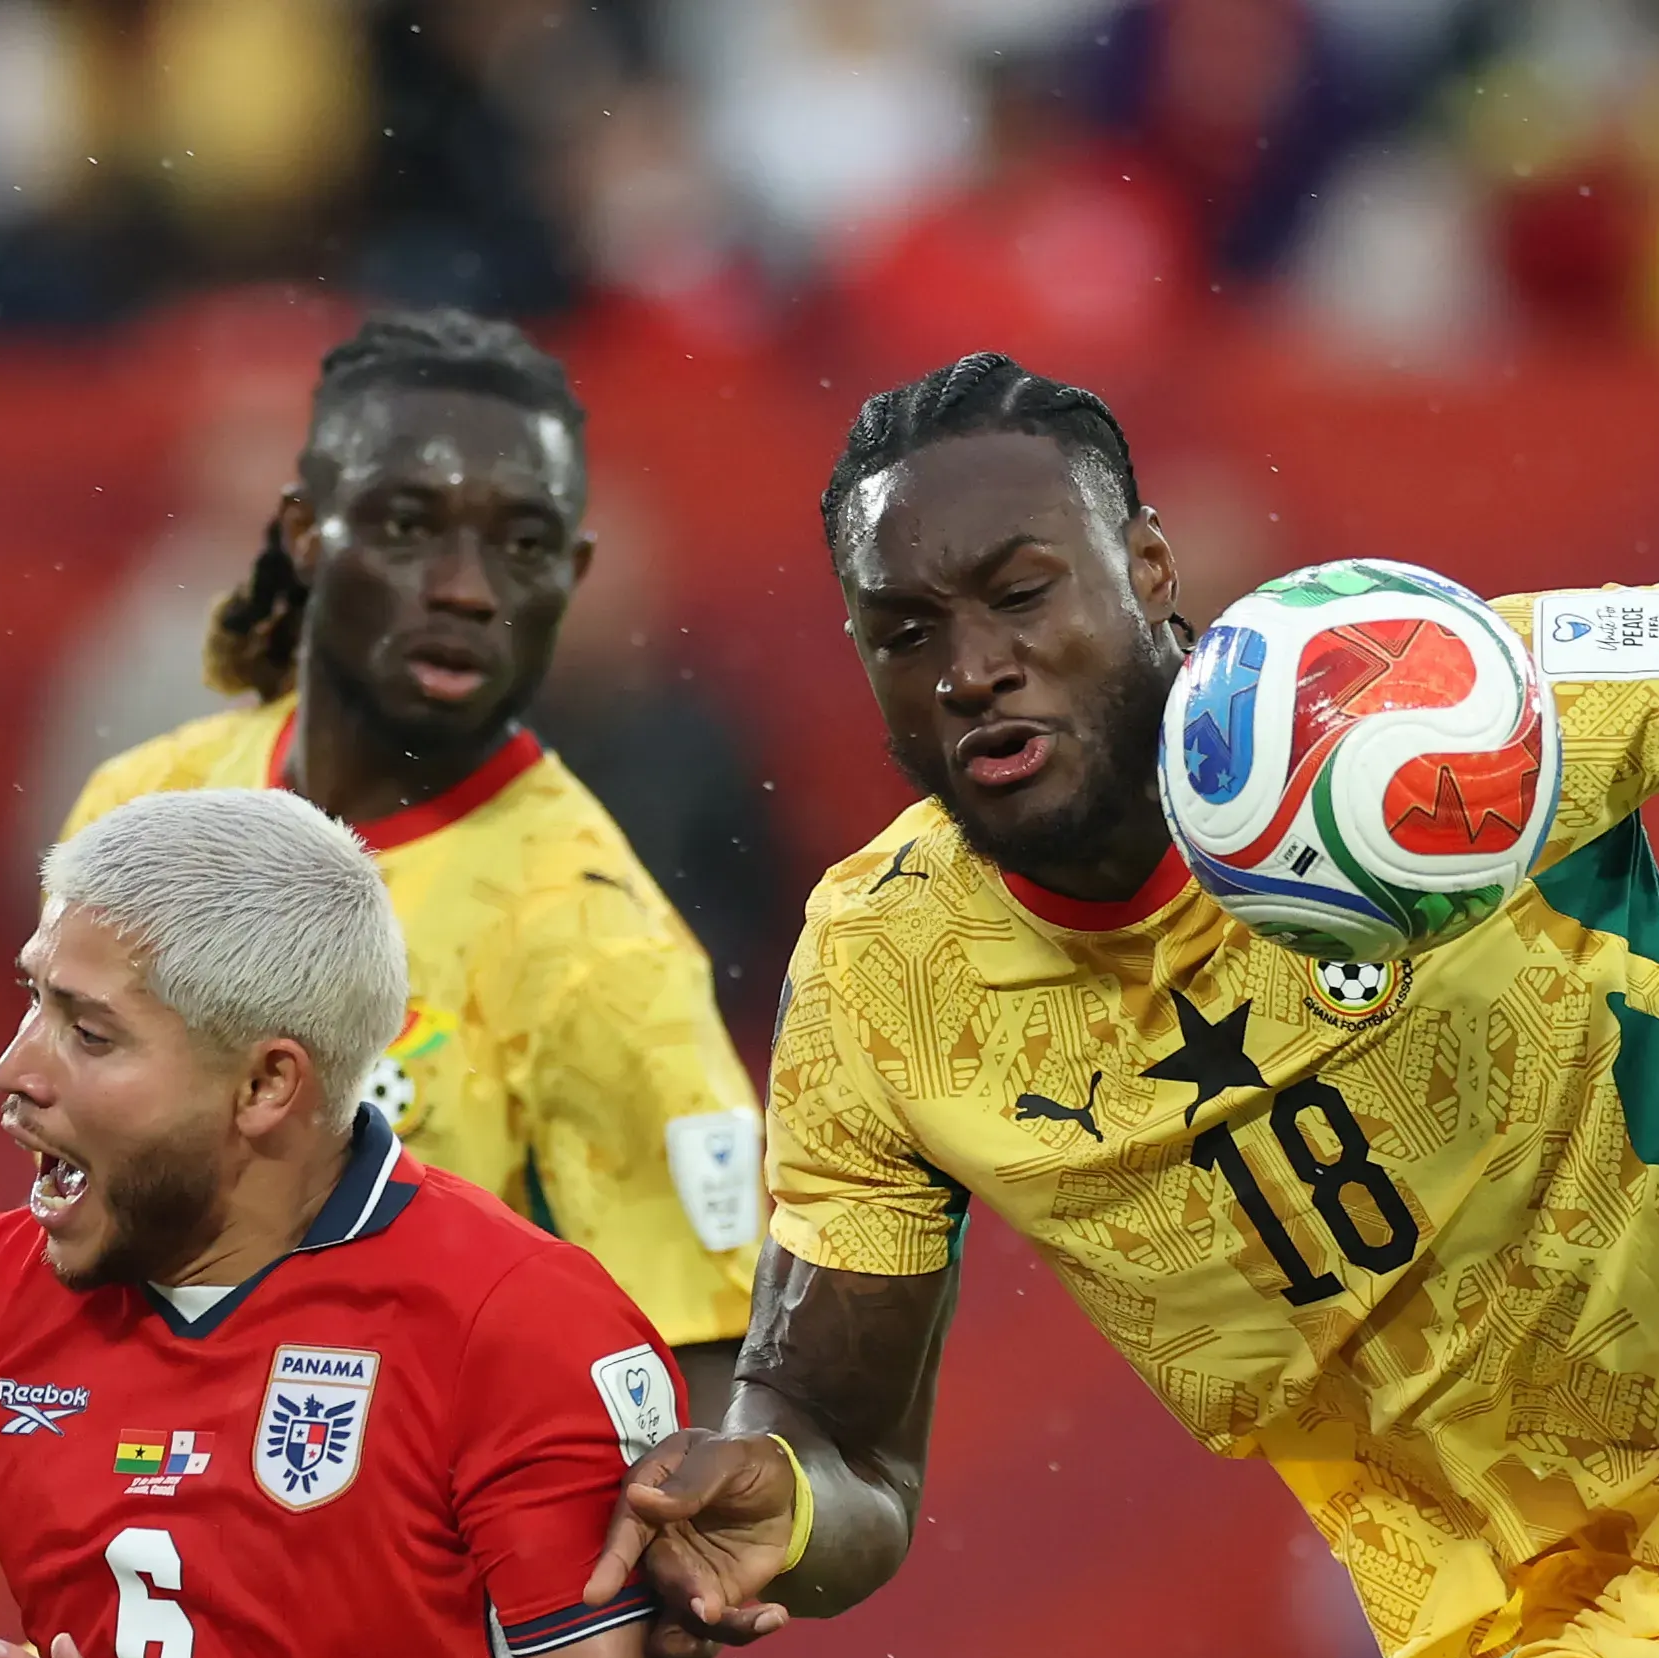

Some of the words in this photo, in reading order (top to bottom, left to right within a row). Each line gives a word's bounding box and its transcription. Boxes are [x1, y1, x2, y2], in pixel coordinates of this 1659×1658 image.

[1622, 607, 1643, 647] PEACE
[1648, 616, 1659, 639] FIFA
[1303, 996, 1338, 1027] GHANA
[1340, 1006, 1397, 1032] FOOTBALL
[1189, 1075, 1419, 1307] 18
[282, 1357, 364, 1379] PANAMÁ
